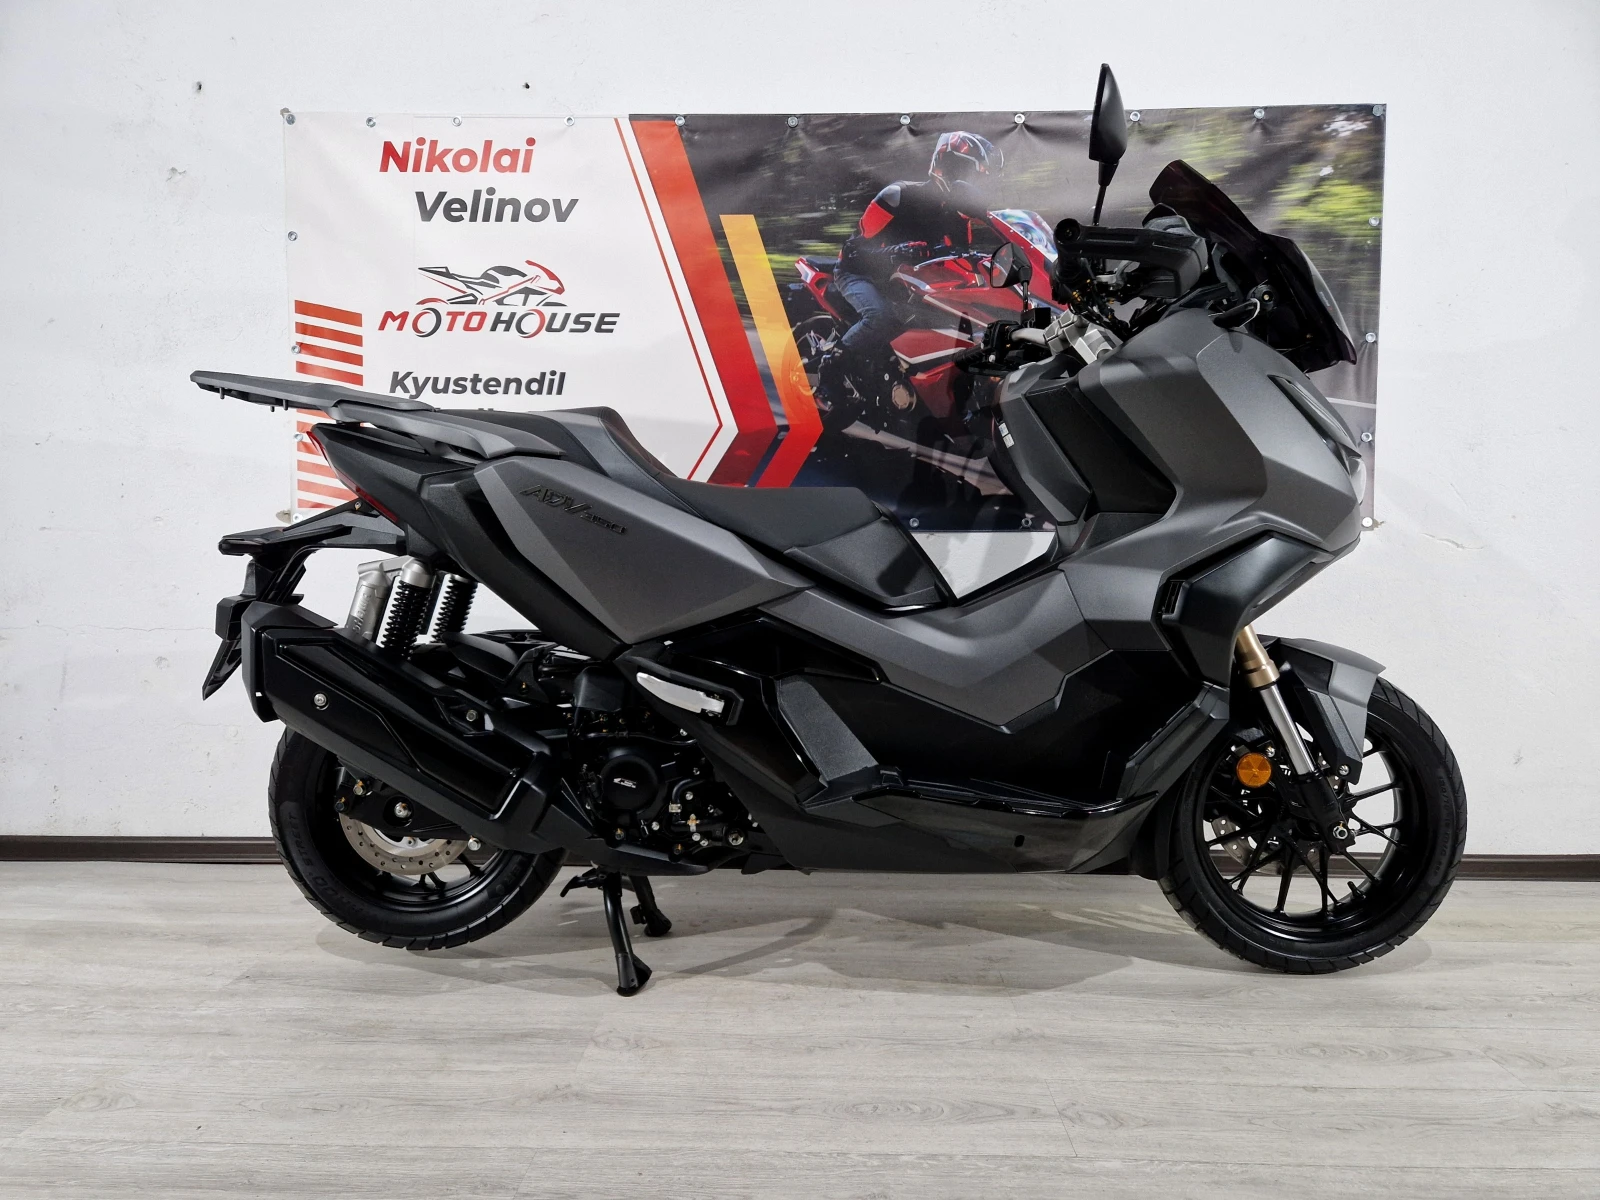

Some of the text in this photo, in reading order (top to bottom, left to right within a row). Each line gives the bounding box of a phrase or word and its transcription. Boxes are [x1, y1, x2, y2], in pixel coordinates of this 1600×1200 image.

[379, 136, 536, 173] Nikolai
[415, 187, 579, 223] Velinov
[389, 369, 567, 399] Kyustendil
